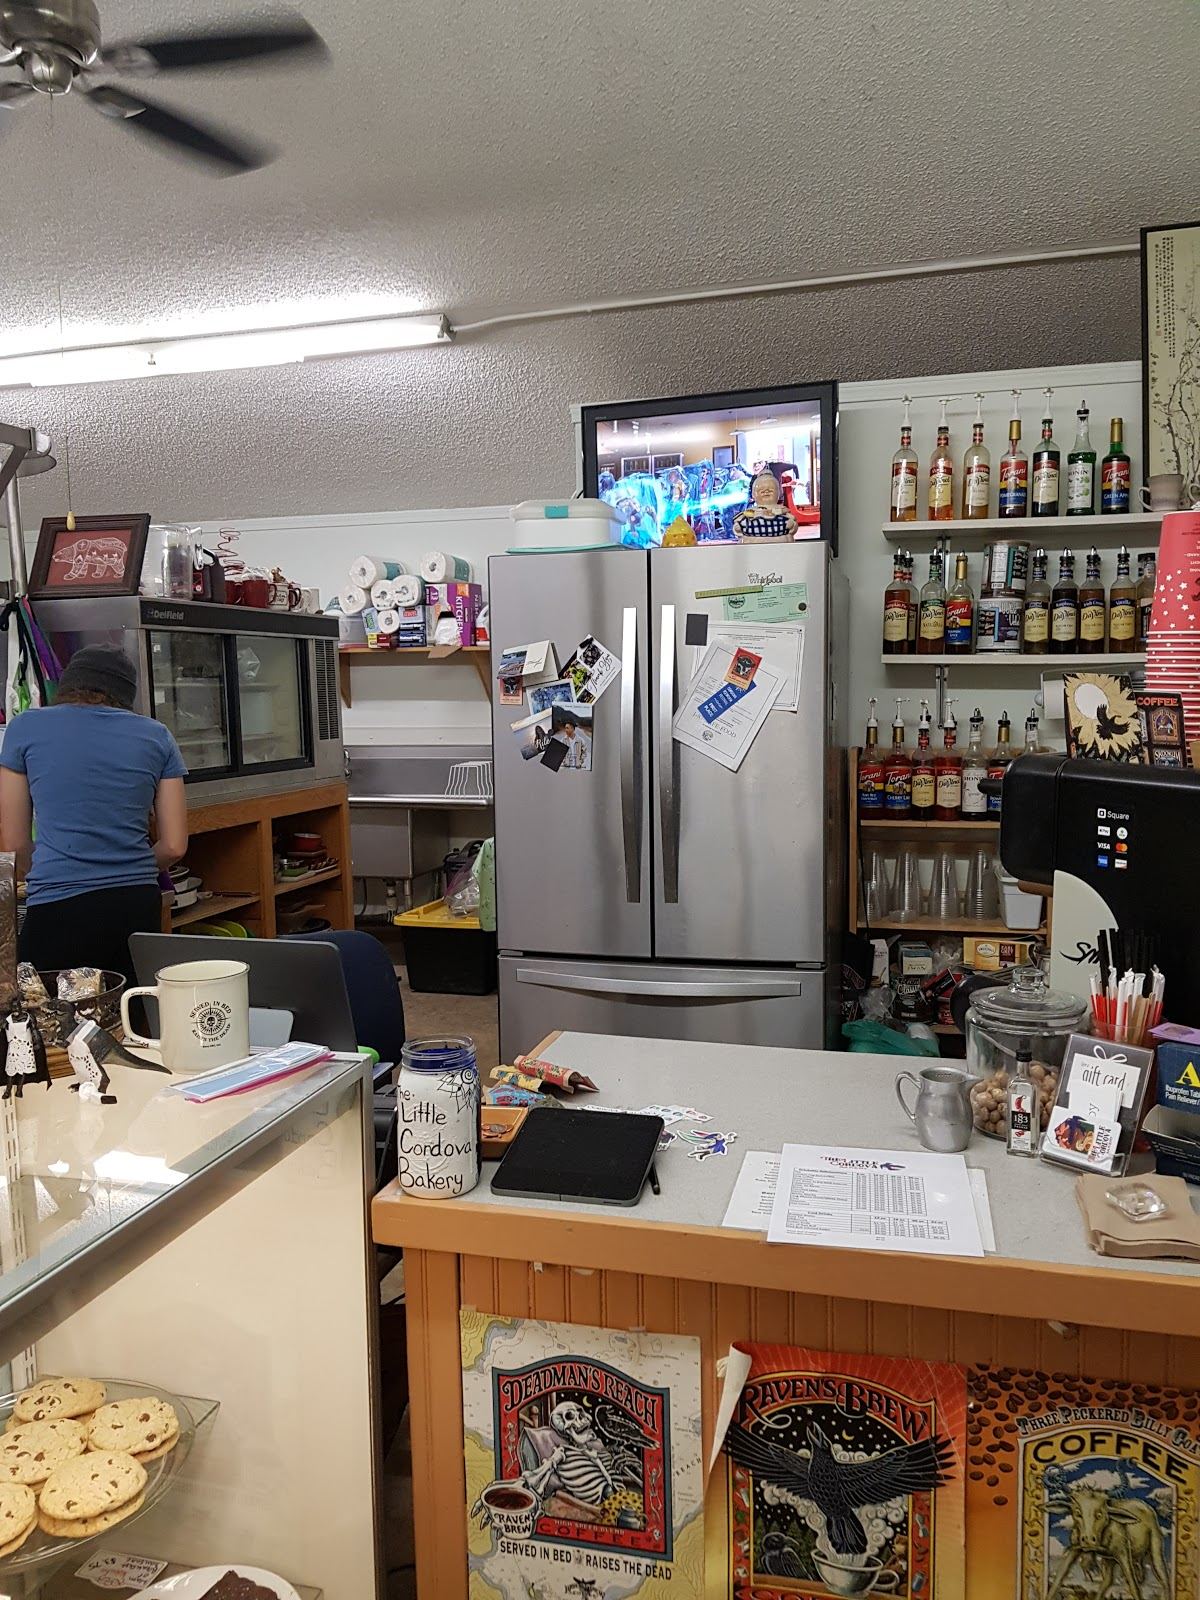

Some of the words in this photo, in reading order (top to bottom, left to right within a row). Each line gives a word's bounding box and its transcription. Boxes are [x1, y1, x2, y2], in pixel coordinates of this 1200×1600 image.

[1136, 696, 1179, 707] COFFEE
[1107, 810, 1130, 821] Square
[1097, 841, 1111, 850] VISA
[220, 1003, 232, 1014] BED
[1165, 1084, 1190, 1096] Ibuprofen
[1165, 1091, 1177, 1099] Pain
[401, 1101, 447, 1125] Little
[400, 1128, 472, 1157] Cordova
[400, 1156, 463, 1194] Bakery
[502, 1364, 601, 1412] DEADMAN'S
[603, 1373, 658, 1433] REACH
[735, 1377, 838, 1429] RAVEN'S
[835, 1382, 929, 1441] BREW
[1017, 1413, 1060, 1436] THREE
[1059, 1406, 1130, 1424] PECKERED
[1130, 1407, 1173, 1439] BILLY
[1033, 1431, 1190, 1485] COFFEE
[503, 1523, 531, 1535] BREW
[539, 1522, 642, 1546] COFFEE
[554, 1518, 573, 1527] HIGH
[575, 1521, 598, 1531] SPEED
[600, 1527, 625, 1535] BLEND
[500, 1541, 537, 1558] SERVED
[540, 1547, 550, 1560] IN
[553, 1549, 572, 1563] BED
[585, 1554, 621, 1572] RAISES
[623, 1561, 643, 1576] THE
[645, 1564, 672, 1580] DEAD
